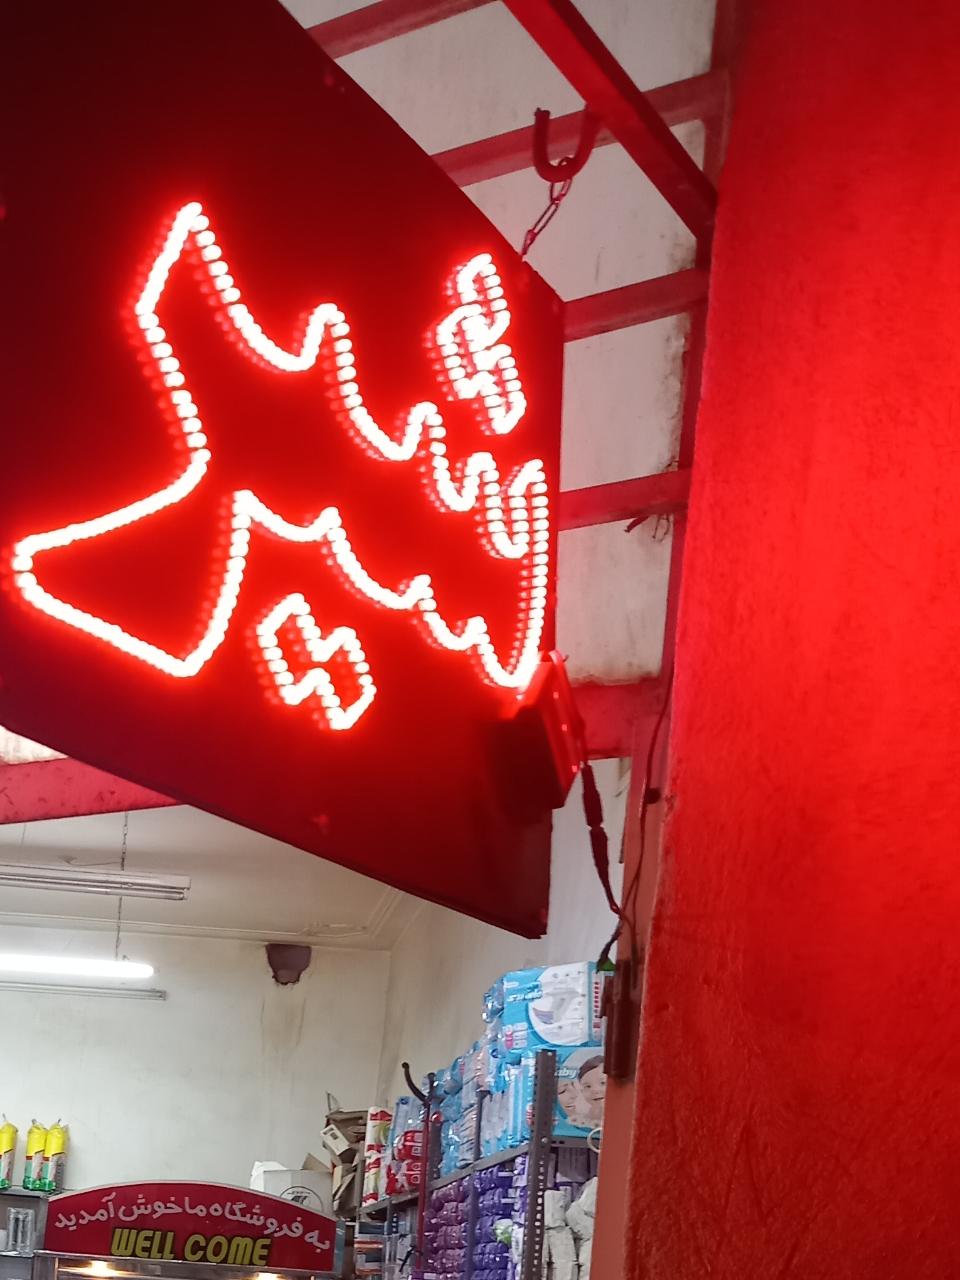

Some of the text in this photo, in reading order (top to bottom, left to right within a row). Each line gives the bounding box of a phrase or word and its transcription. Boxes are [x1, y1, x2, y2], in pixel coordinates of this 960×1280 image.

[54, 1192, 330, 1253] به فروشگاه ما خوش آمدید
[111, 1228, 273, 1265] WELL COME
